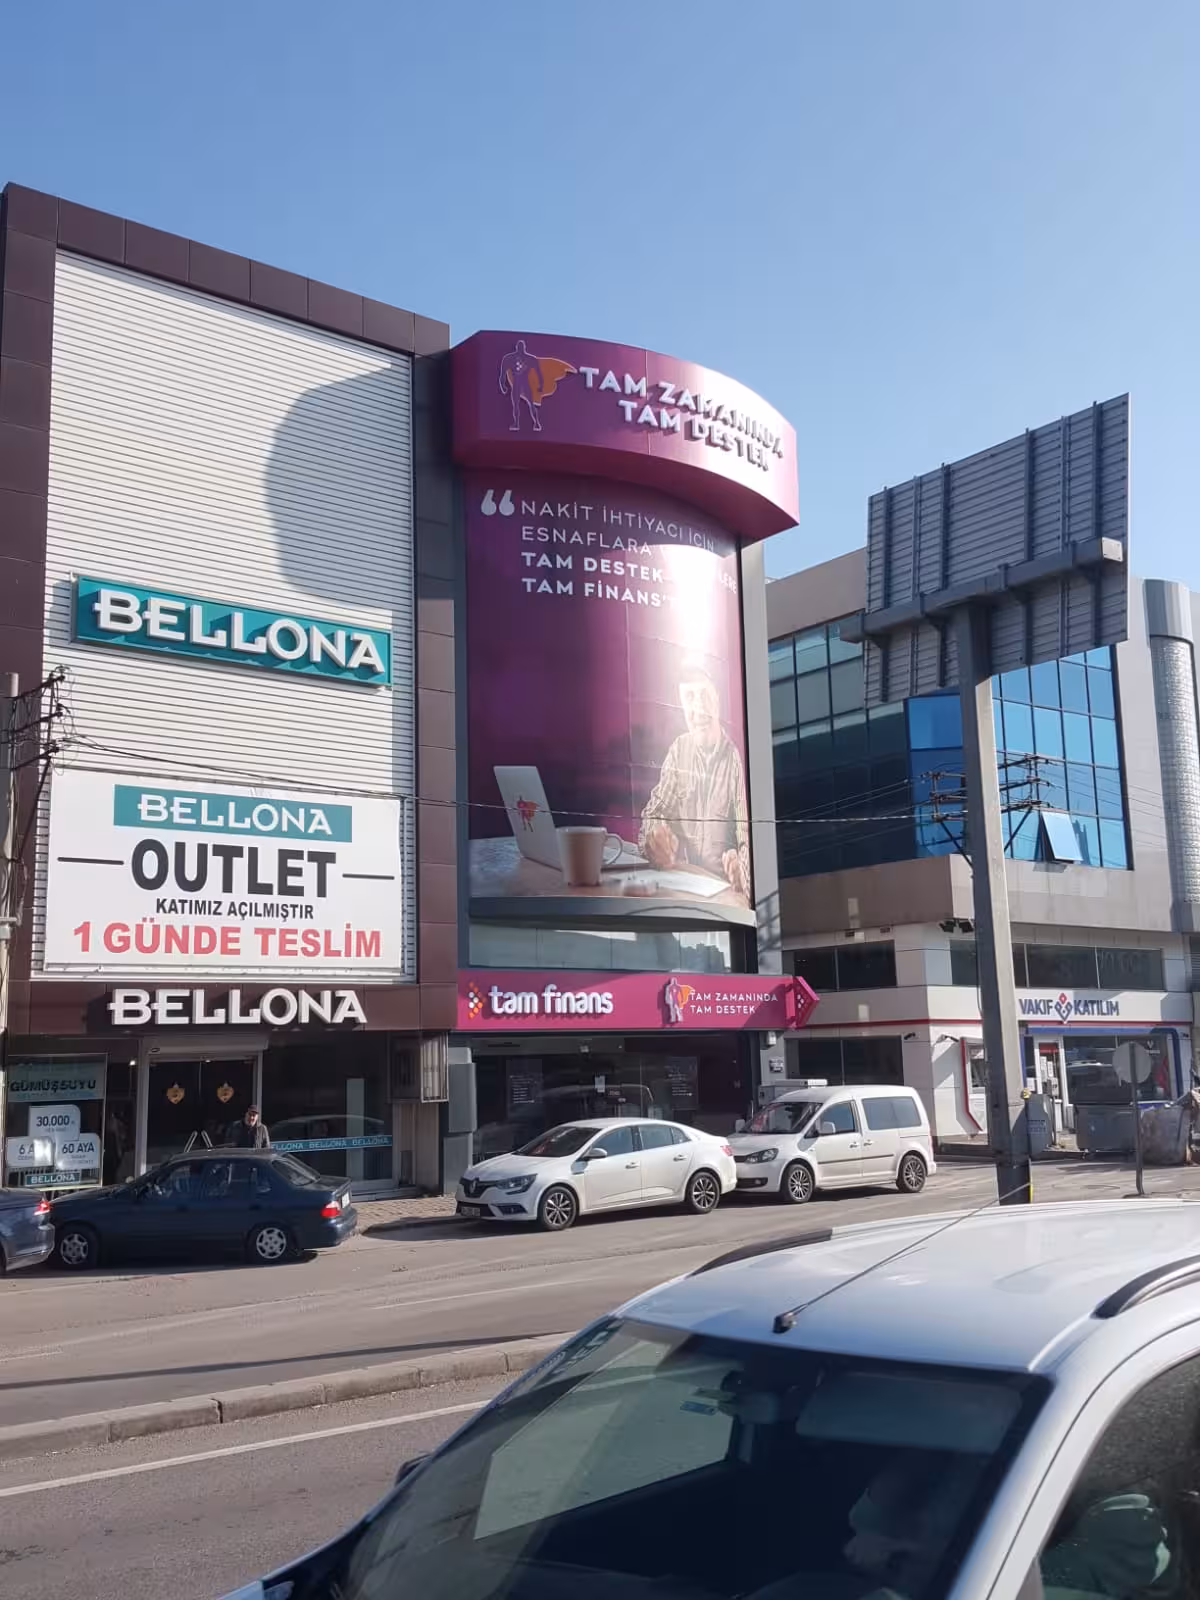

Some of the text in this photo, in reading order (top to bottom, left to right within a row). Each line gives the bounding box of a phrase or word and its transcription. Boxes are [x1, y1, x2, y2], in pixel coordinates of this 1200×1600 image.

[579, 366, 647, 397] TAM
[618, 400, 681, 432] TAM
[521, 500, 593, 521] NAKİT
[521, 526, 653, 557] ESNAFLARA
[521, 551, 664, 584] TAM DESTEK
[521, 577, 574, 597] TAM
[93, 588, 386, 674] BELLONA
[137, 793, 333, 836] BELLONA
[131, 838, 337, 898] OUTLET
[155, 898, 315, 922] KATIMIZ AÇILMIŞTIR
[74, 917, 382, 958] 1 GÜNDE TESLİM
[107, 987, 368, 1026] BELLONA
[489, 984, 614, 1015] tam finans
[690, 991, 778, 1003] TAM ZAMANINDA
[690, 1004, 756, 1015] TAM DESTEK
[1019, 998, 1119, 1017] VAKIF KATILIM
[36, 1115, 70, 1127] 30.000
[62, 1143, 74, 1154] 60
[76, 1142, 95, 1153] AYA
[271, 1141, 304, 1151] ELLONA
[31, 1173, 76, 1184] BELLONA
